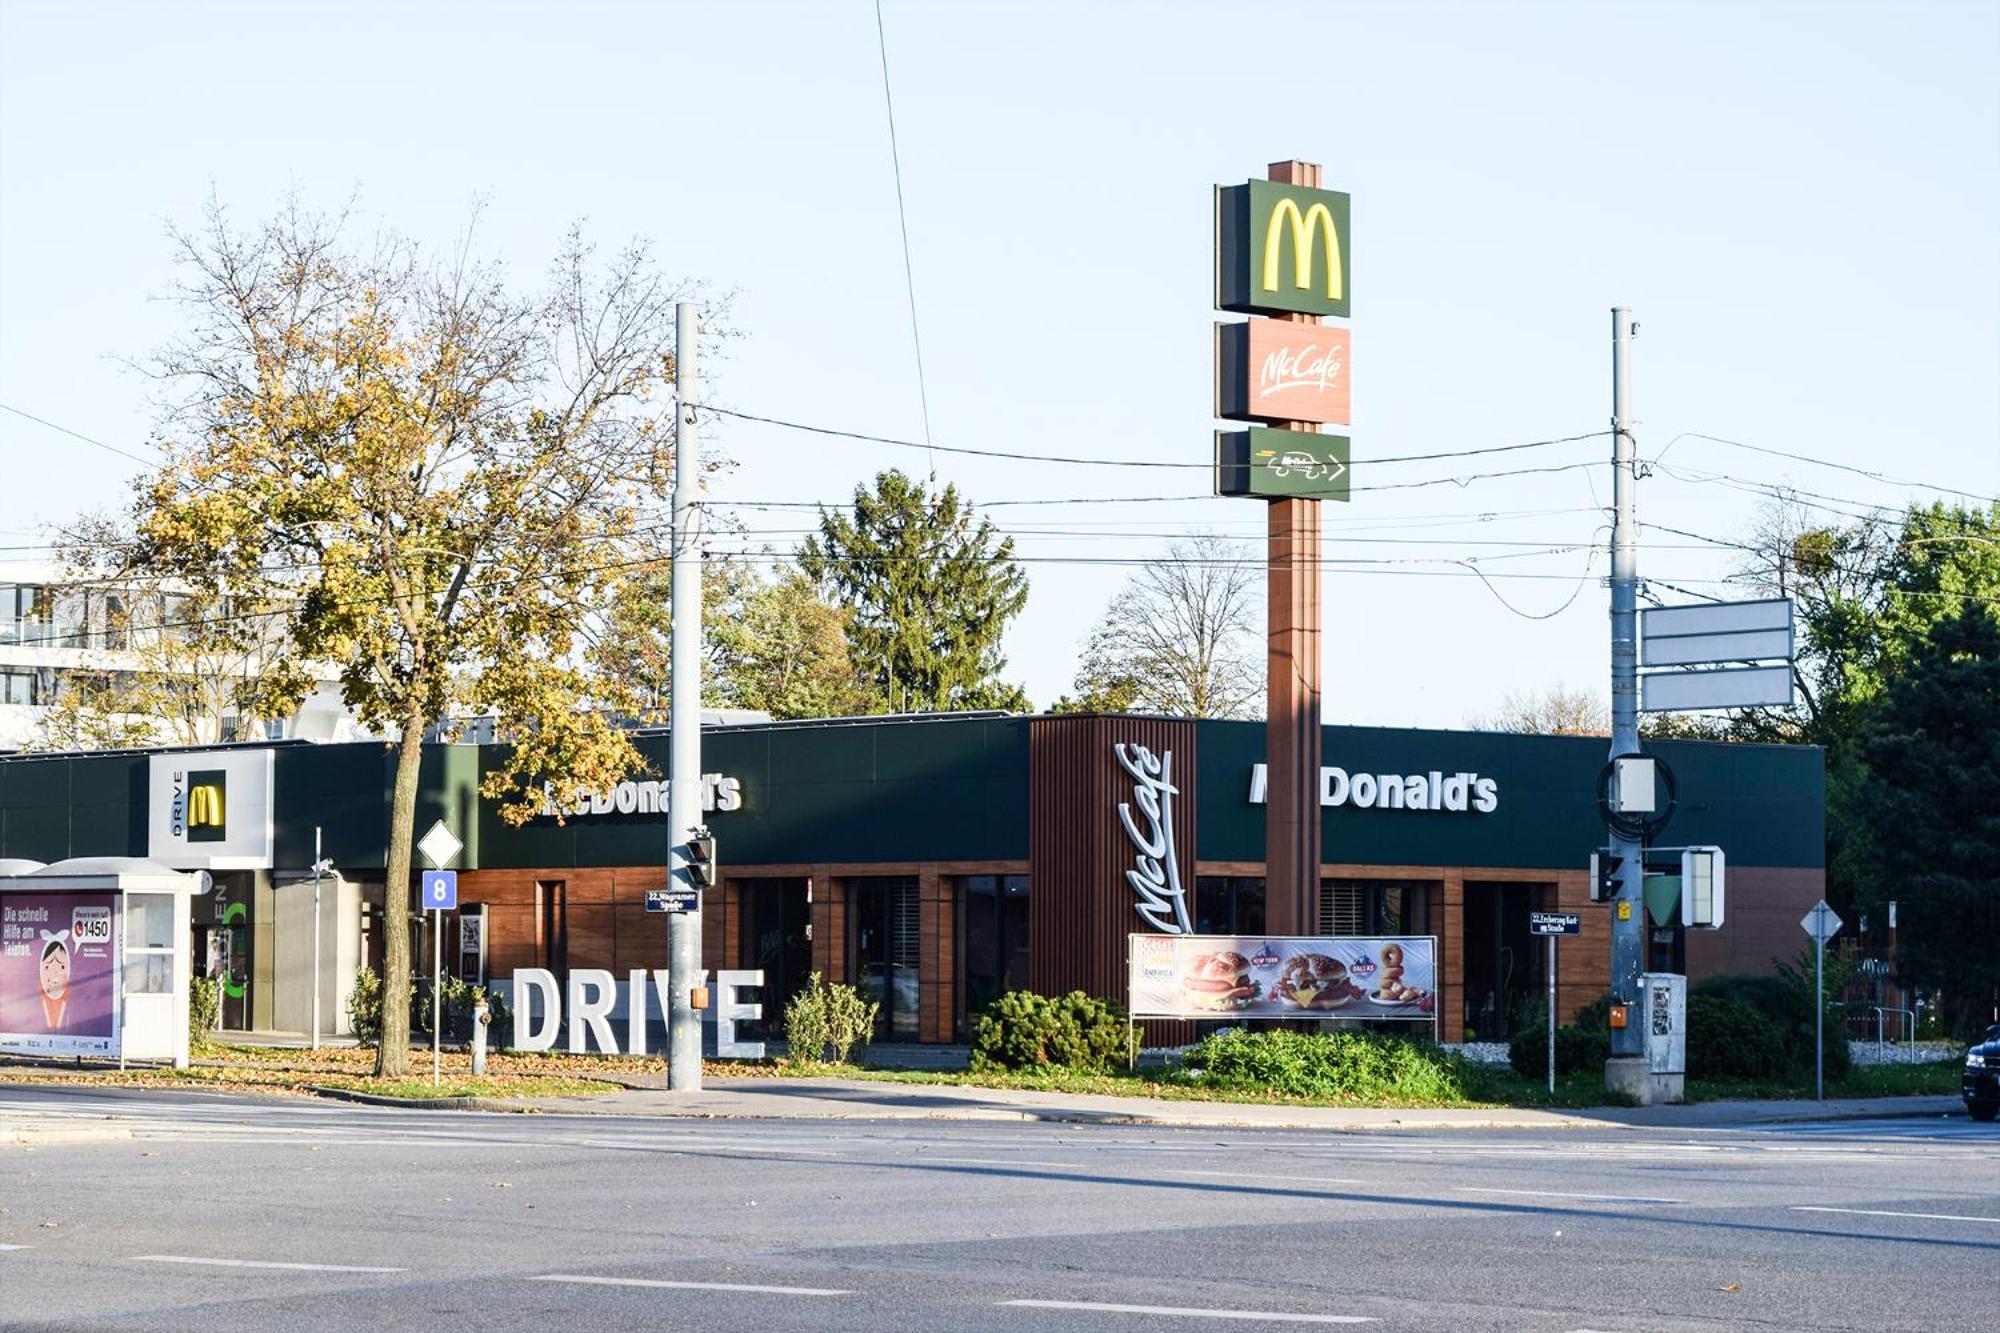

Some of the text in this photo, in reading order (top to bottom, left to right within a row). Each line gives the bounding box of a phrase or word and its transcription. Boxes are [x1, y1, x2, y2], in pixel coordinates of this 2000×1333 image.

[1264, 198, 1342, 300] M
[1260, 344, 1344, 394] McCafé
[1249, 763, 1498, 813] Donald's
[173, 770, 182, 837] DRIVE
[1114, 743, 1190, 934] McCafé
[433, 878, 447, 902] 8
[4, 907, 49, 922] Die schnelle
[4, 924, 34, 939] Hilfe am
[84, 920, 109, 937] 1450
[4, 942, 31, 956] Telefon.
[1265, 956, 1279, 964] YORK
[1352, 964, 1375, 972] DALLAS
